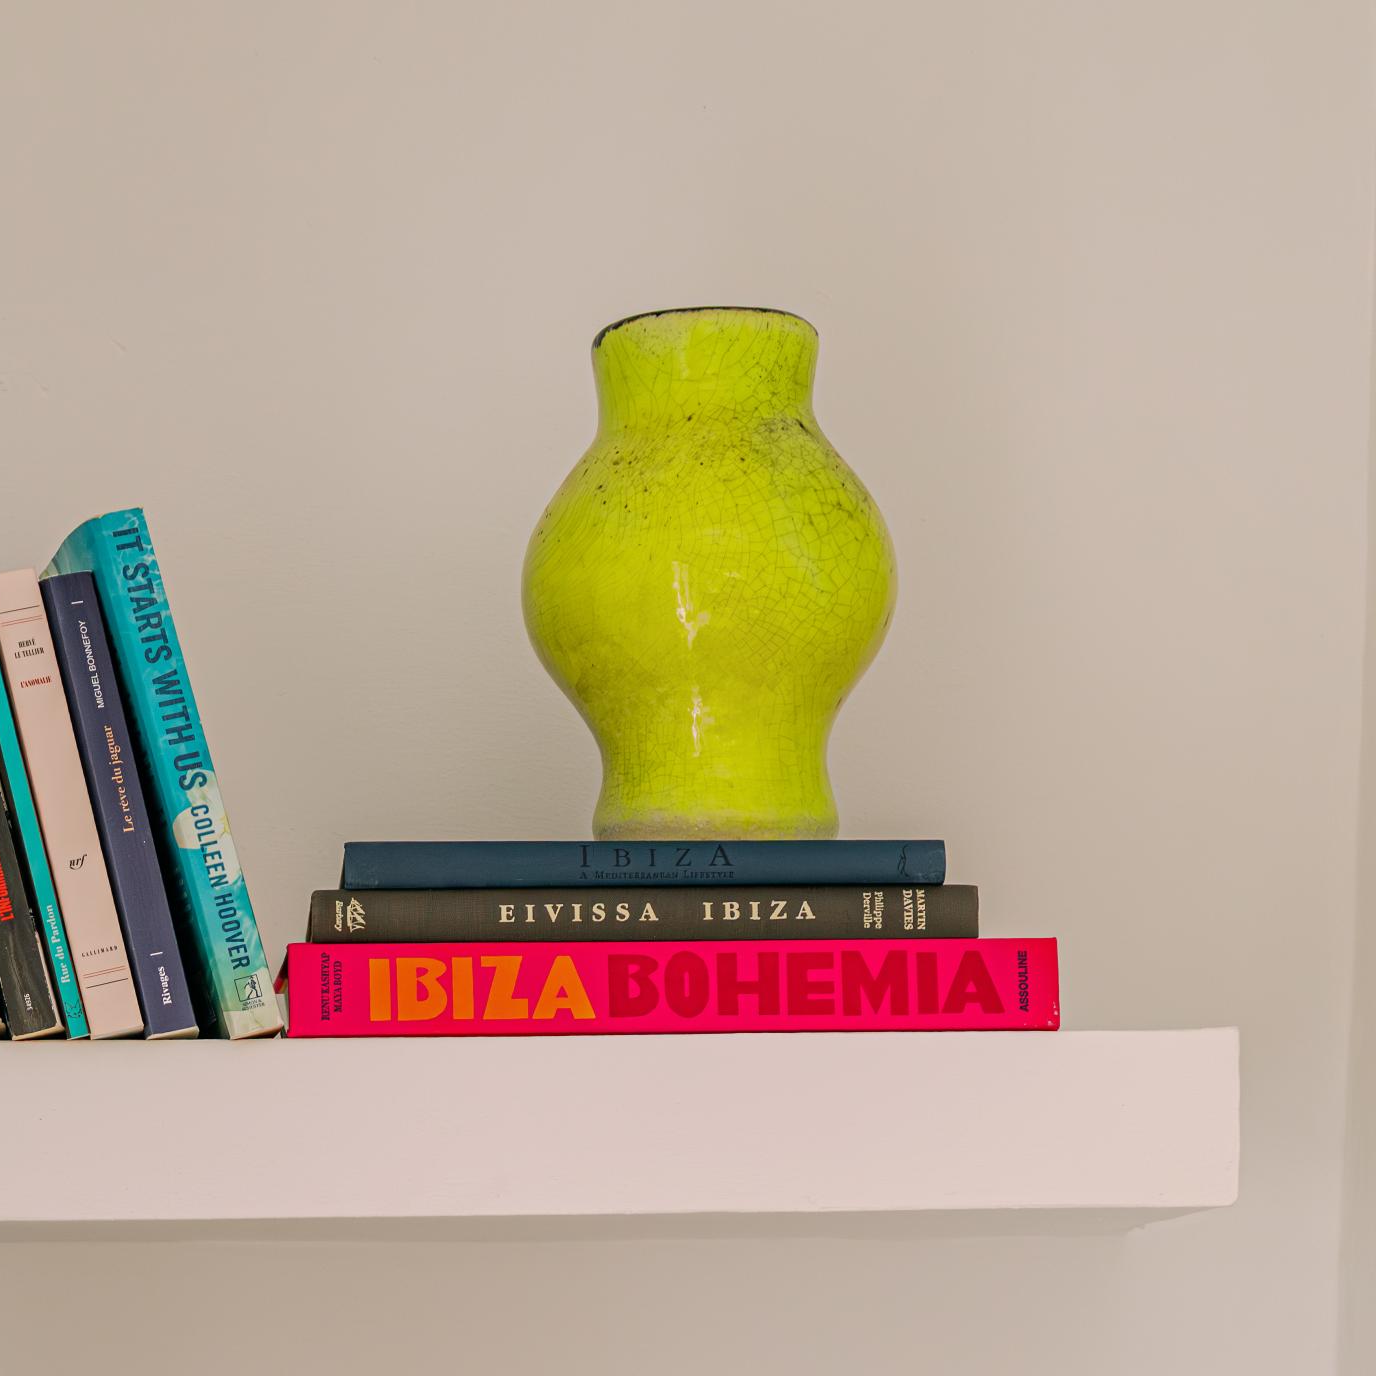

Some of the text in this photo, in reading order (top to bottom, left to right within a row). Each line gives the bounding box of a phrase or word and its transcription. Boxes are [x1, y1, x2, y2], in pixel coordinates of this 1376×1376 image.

[78, 619, 106, 710] MIGUEL BONNEFOY
[112, 526, 209, 792] IT STARTS WITH US
[104, 724, 124, 765] jaguar
[111, 767, 124, 783] du
[123, 814, 135, 833] Le
[579, 843, 736, 868] IBIZA
[190, 803, 251, 971] COLLEEN HOOVER
[498, 900, 816, 923] EIVISSA IBIZA
[863, 892, 872, 929] Derville
[874, 890, 884, 930] Philippe
[903, 889, 913, 931] DAVIES
[916, 889, 926, 931] MARTIN
[46, 904, 72, 984] Rue du Pardon
[158, 965, 173, 1006] Rivages
[368, 949, 1006, 1022] IBIZA BOHEMIA
[1018, 949, 1028, 1012] ASSOULINE
